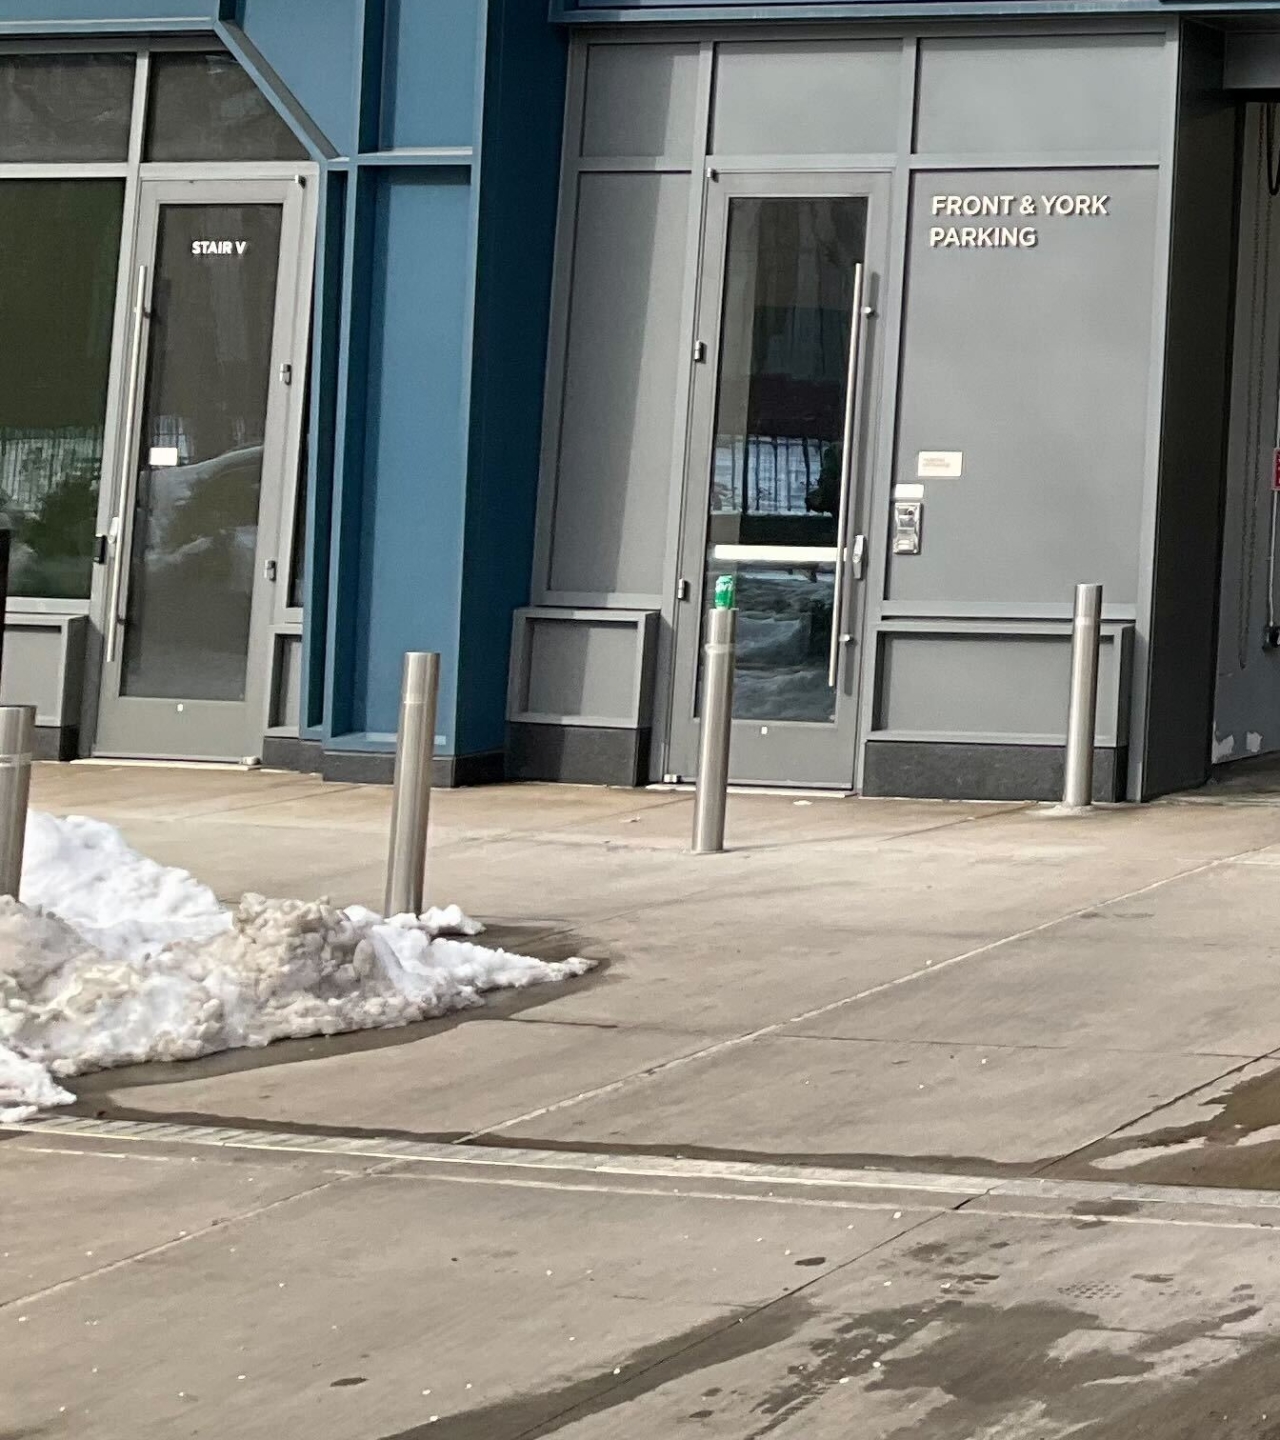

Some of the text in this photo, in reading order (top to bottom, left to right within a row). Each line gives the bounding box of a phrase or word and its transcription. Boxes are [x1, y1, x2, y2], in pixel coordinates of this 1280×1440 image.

[931, 194, 1110, 216] FRONT & YORK
[191, 240, 247, 255] STAIR V
[929, 227, 1038, 248] PARKING
